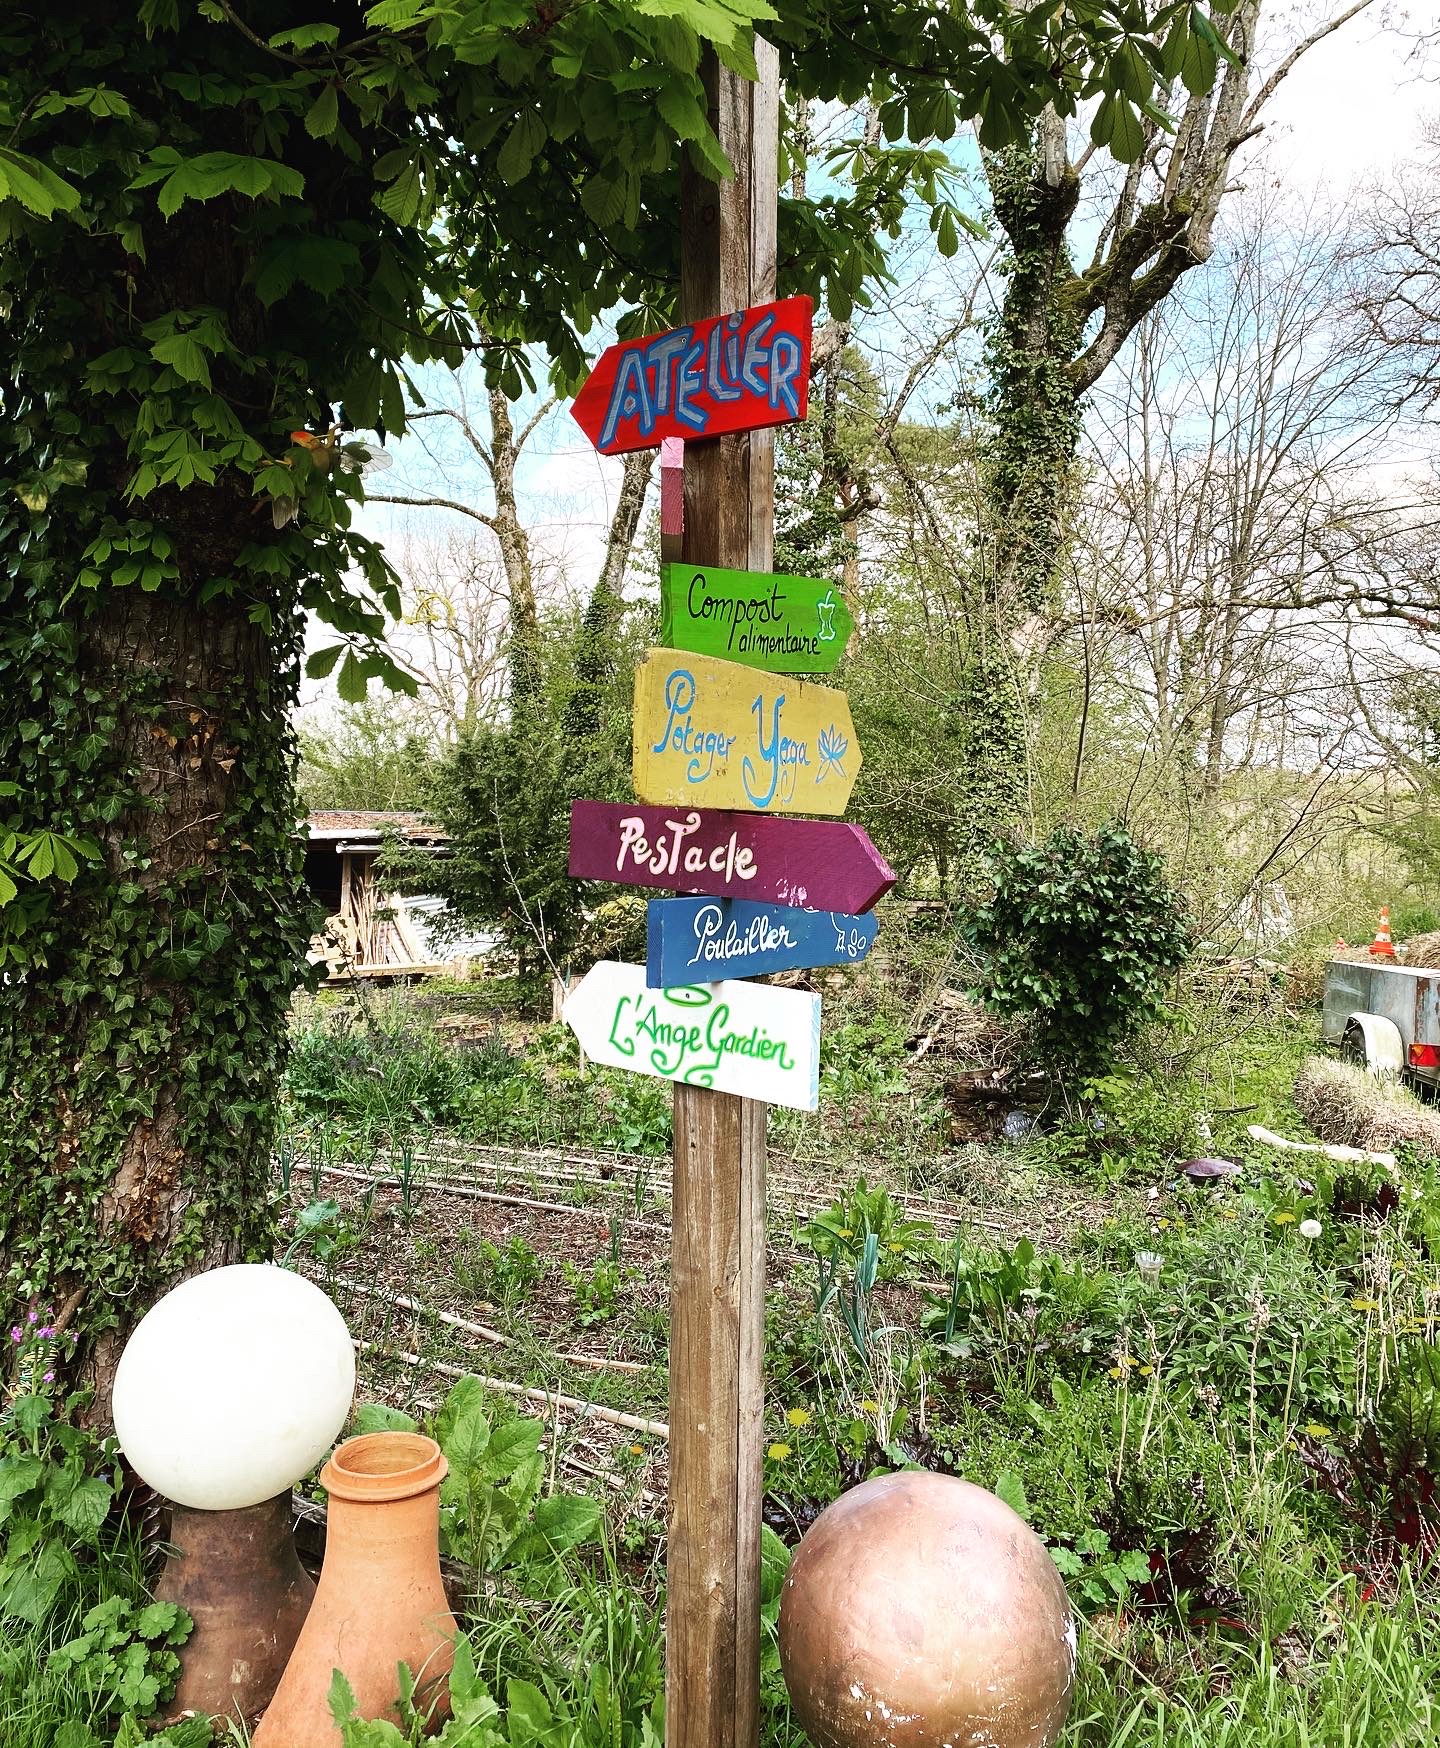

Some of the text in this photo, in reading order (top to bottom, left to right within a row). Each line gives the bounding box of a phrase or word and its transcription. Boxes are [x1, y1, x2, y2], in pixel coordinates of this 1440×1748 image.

[687, 573, 787, 650] Compost
[738, 622, 823, 656] alimentaire
[653, 669, 811, 808] Potager Yoga
[687, 904, 797, 967] Poulailler
[609, 994, 795, 1088] L'Ange Gardien
